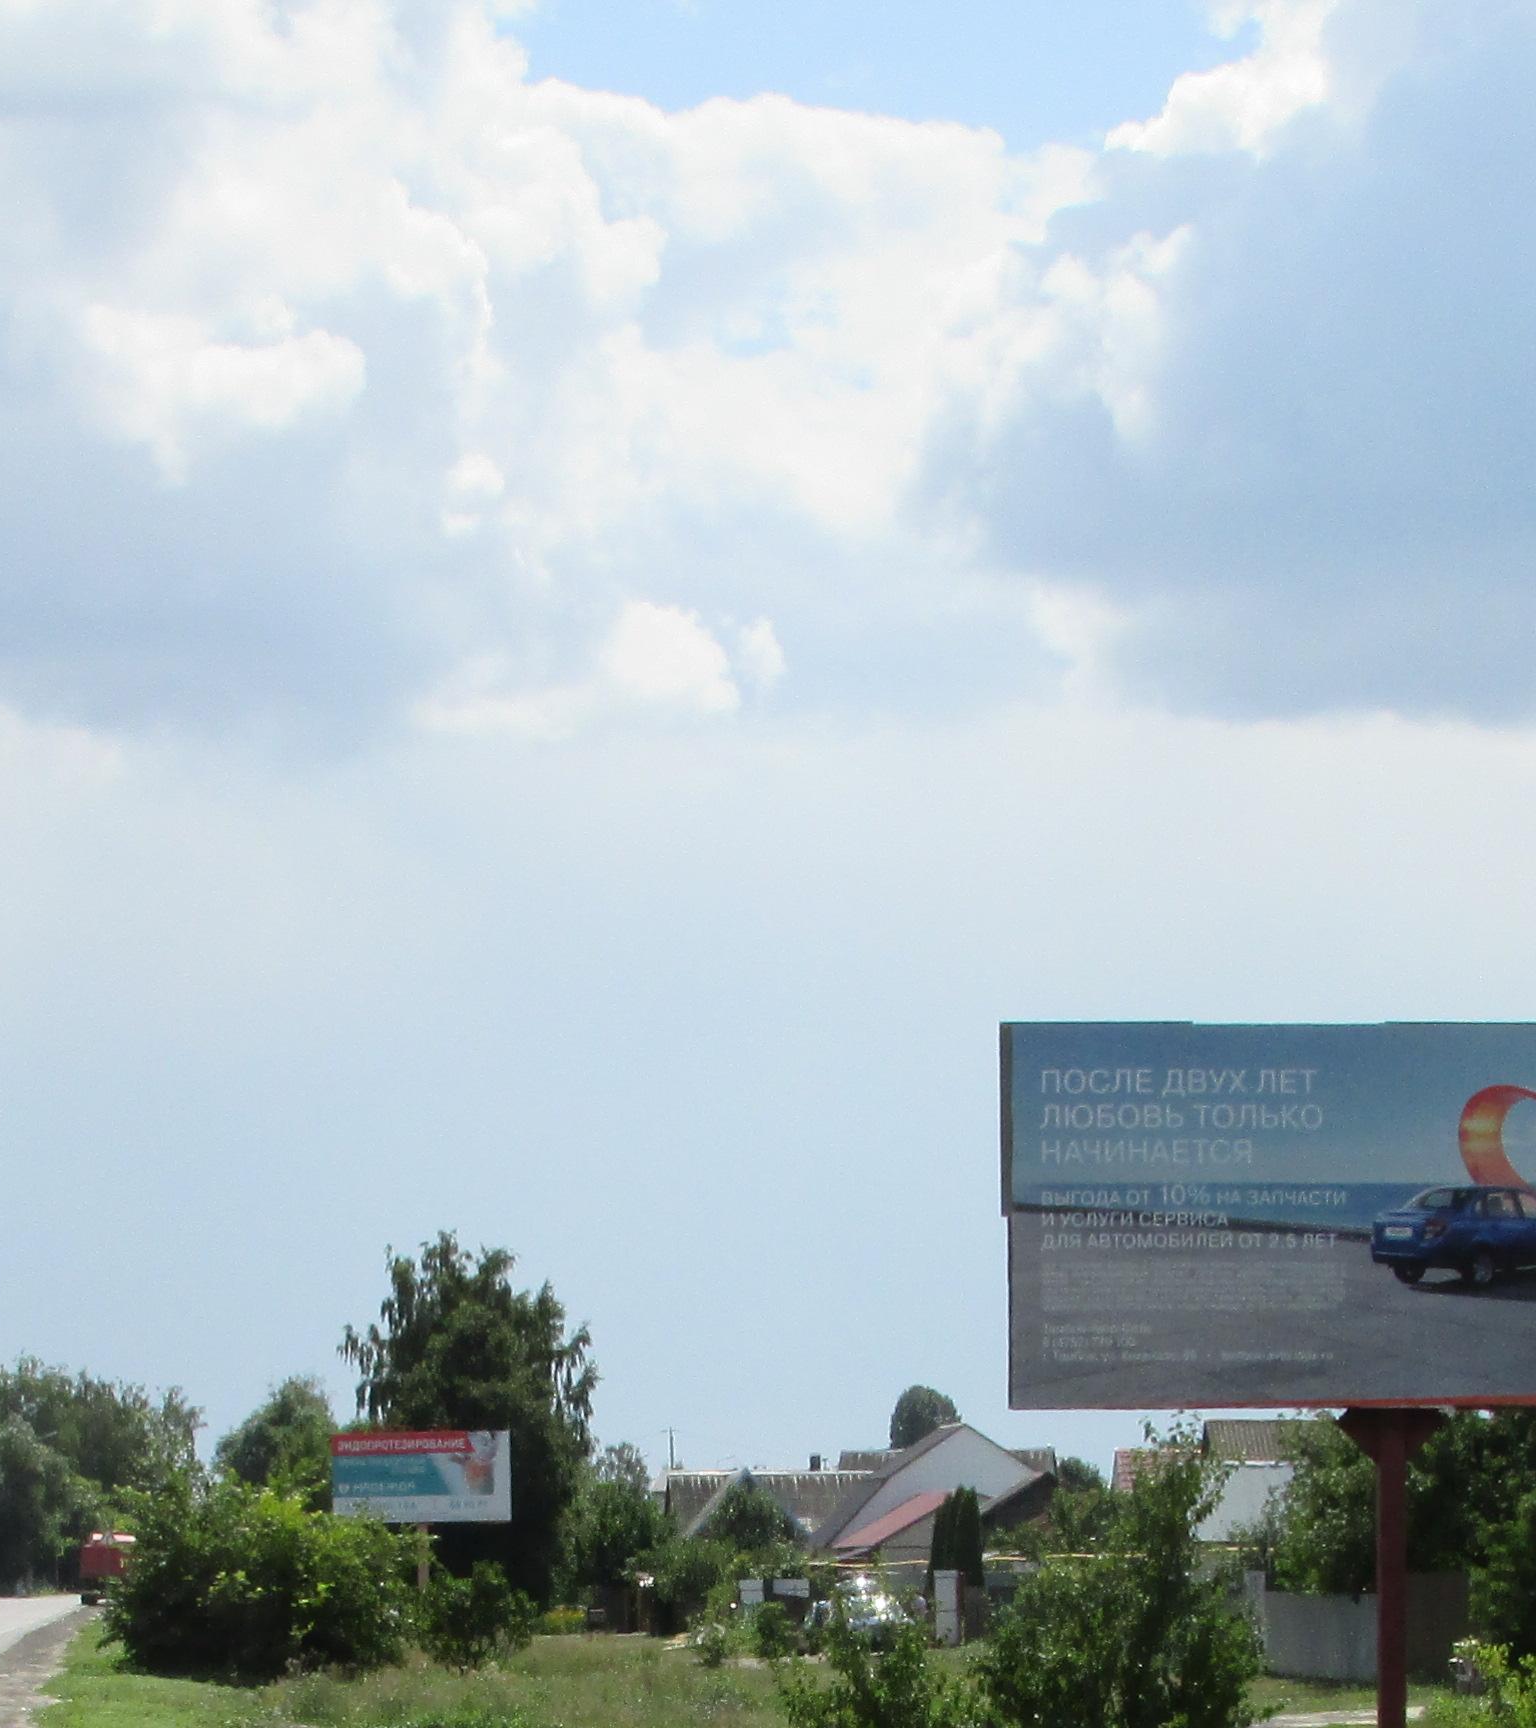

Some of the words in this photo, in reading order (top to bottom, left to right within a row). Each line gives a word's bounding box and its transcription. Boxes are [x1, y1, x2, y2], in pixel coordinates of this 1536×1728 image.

[1040, 1069, 1154, 1094] ПОСЛЕ
[1161, 1069, 1248, 1098] ДВУХ
[1256, 1069, 1320, 1094] ЛЕТ
[1040, 1103, 1185, 1130] ЛЮБОВЬ
[1193, 1103, 1323, 1129] ТОЛЬКО
[1040, 1139, 1254, 1165] НАЧИНАЕТСЯ
[1041, 1190, 1122, 1207] ВЫГОДА
[1125, 1189, 1151, 1206] ОТ
[1160, 1184, 1211, 1206] 10%
[1216, 1190, 1242, 1206] НА
[1246, 1190, 1348, 1206] ЗАПЧАСТИ
[1041, 1212, 1055, 1227] И
[1060, 1212, 1135, 1228] УСЛУГИ
[1138, 1211, 1230, 1227] СЕРВИСА
[1041, 1232, 1082, 1250] ДЛЯ
[1085, 1231, 1234, 1249] АВТОМОБИЛЕЙ
[1238, 1232, 1263, 1248] ОТ
[1301, 1232, 1340, 1248] ЛЕТ
[338, 1438, 466, 1452] ЭНДОПРОТЕЗИРОВАНИЕ
